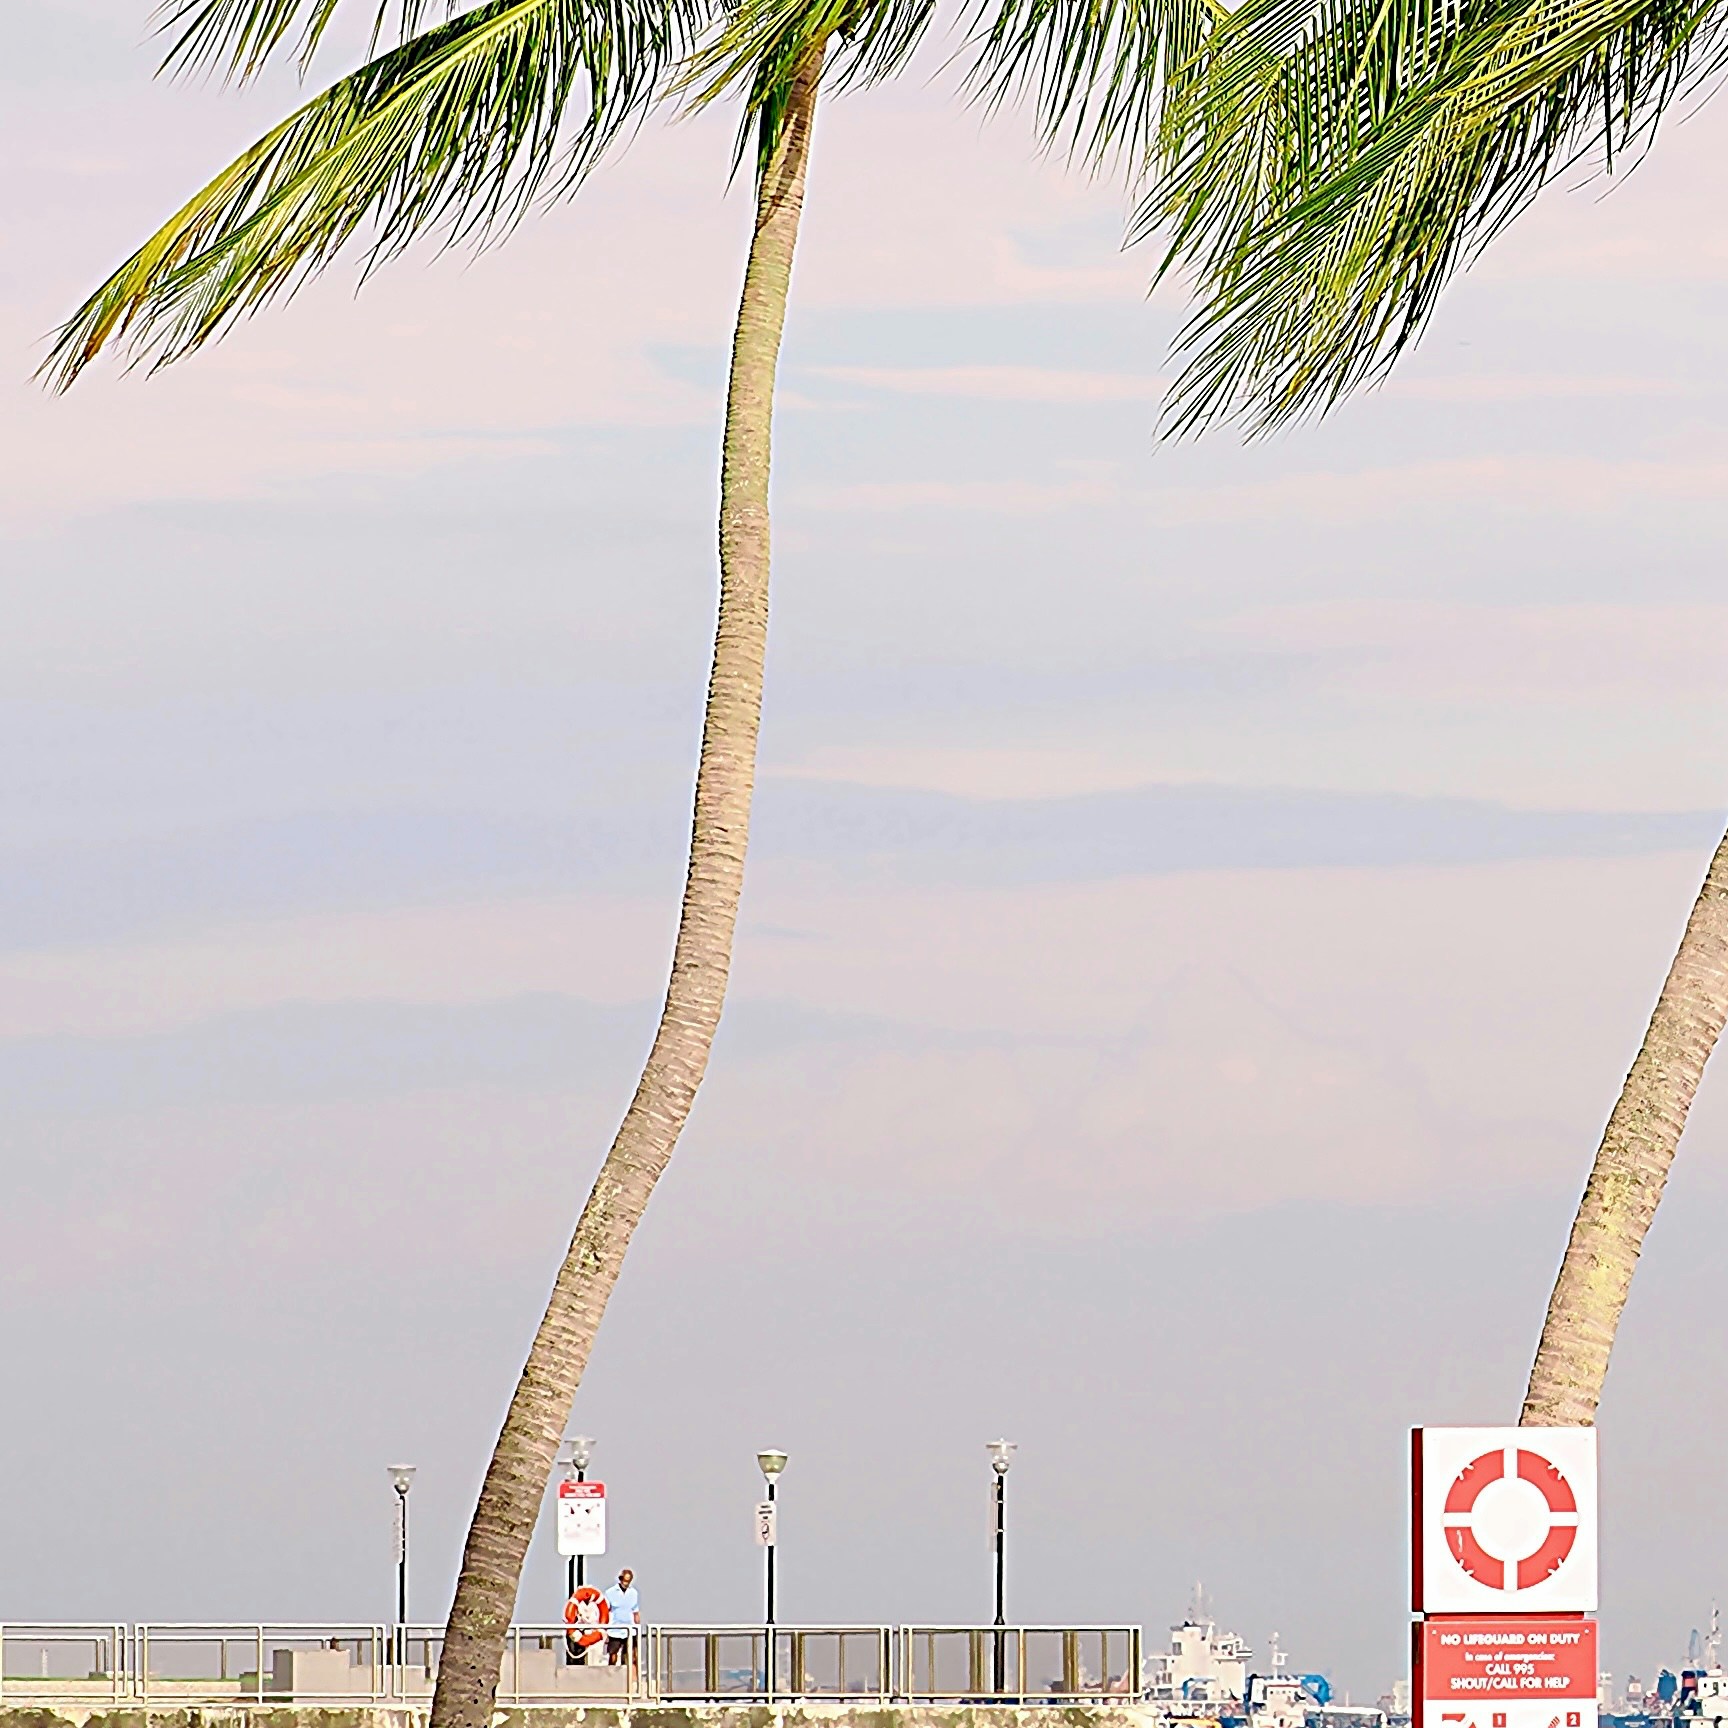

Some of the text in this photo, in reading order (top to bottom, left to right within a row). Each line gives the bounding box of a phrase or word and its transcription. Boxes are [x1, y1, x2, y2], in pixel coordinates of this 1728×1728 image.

[1440, 1633, 1580, 1645] NO LIFEGUARD ON DUTY
[1494, 1651, 1503, 1661] of
[1485, 1663, 1535, 1675] CALL 995
[1450, 1676, 1571, 1691] SHOUT/CALL FOR HELP
[1497, 1715, 1503, 1726] 1
[1570, 1714, 1577, 1725] 2
